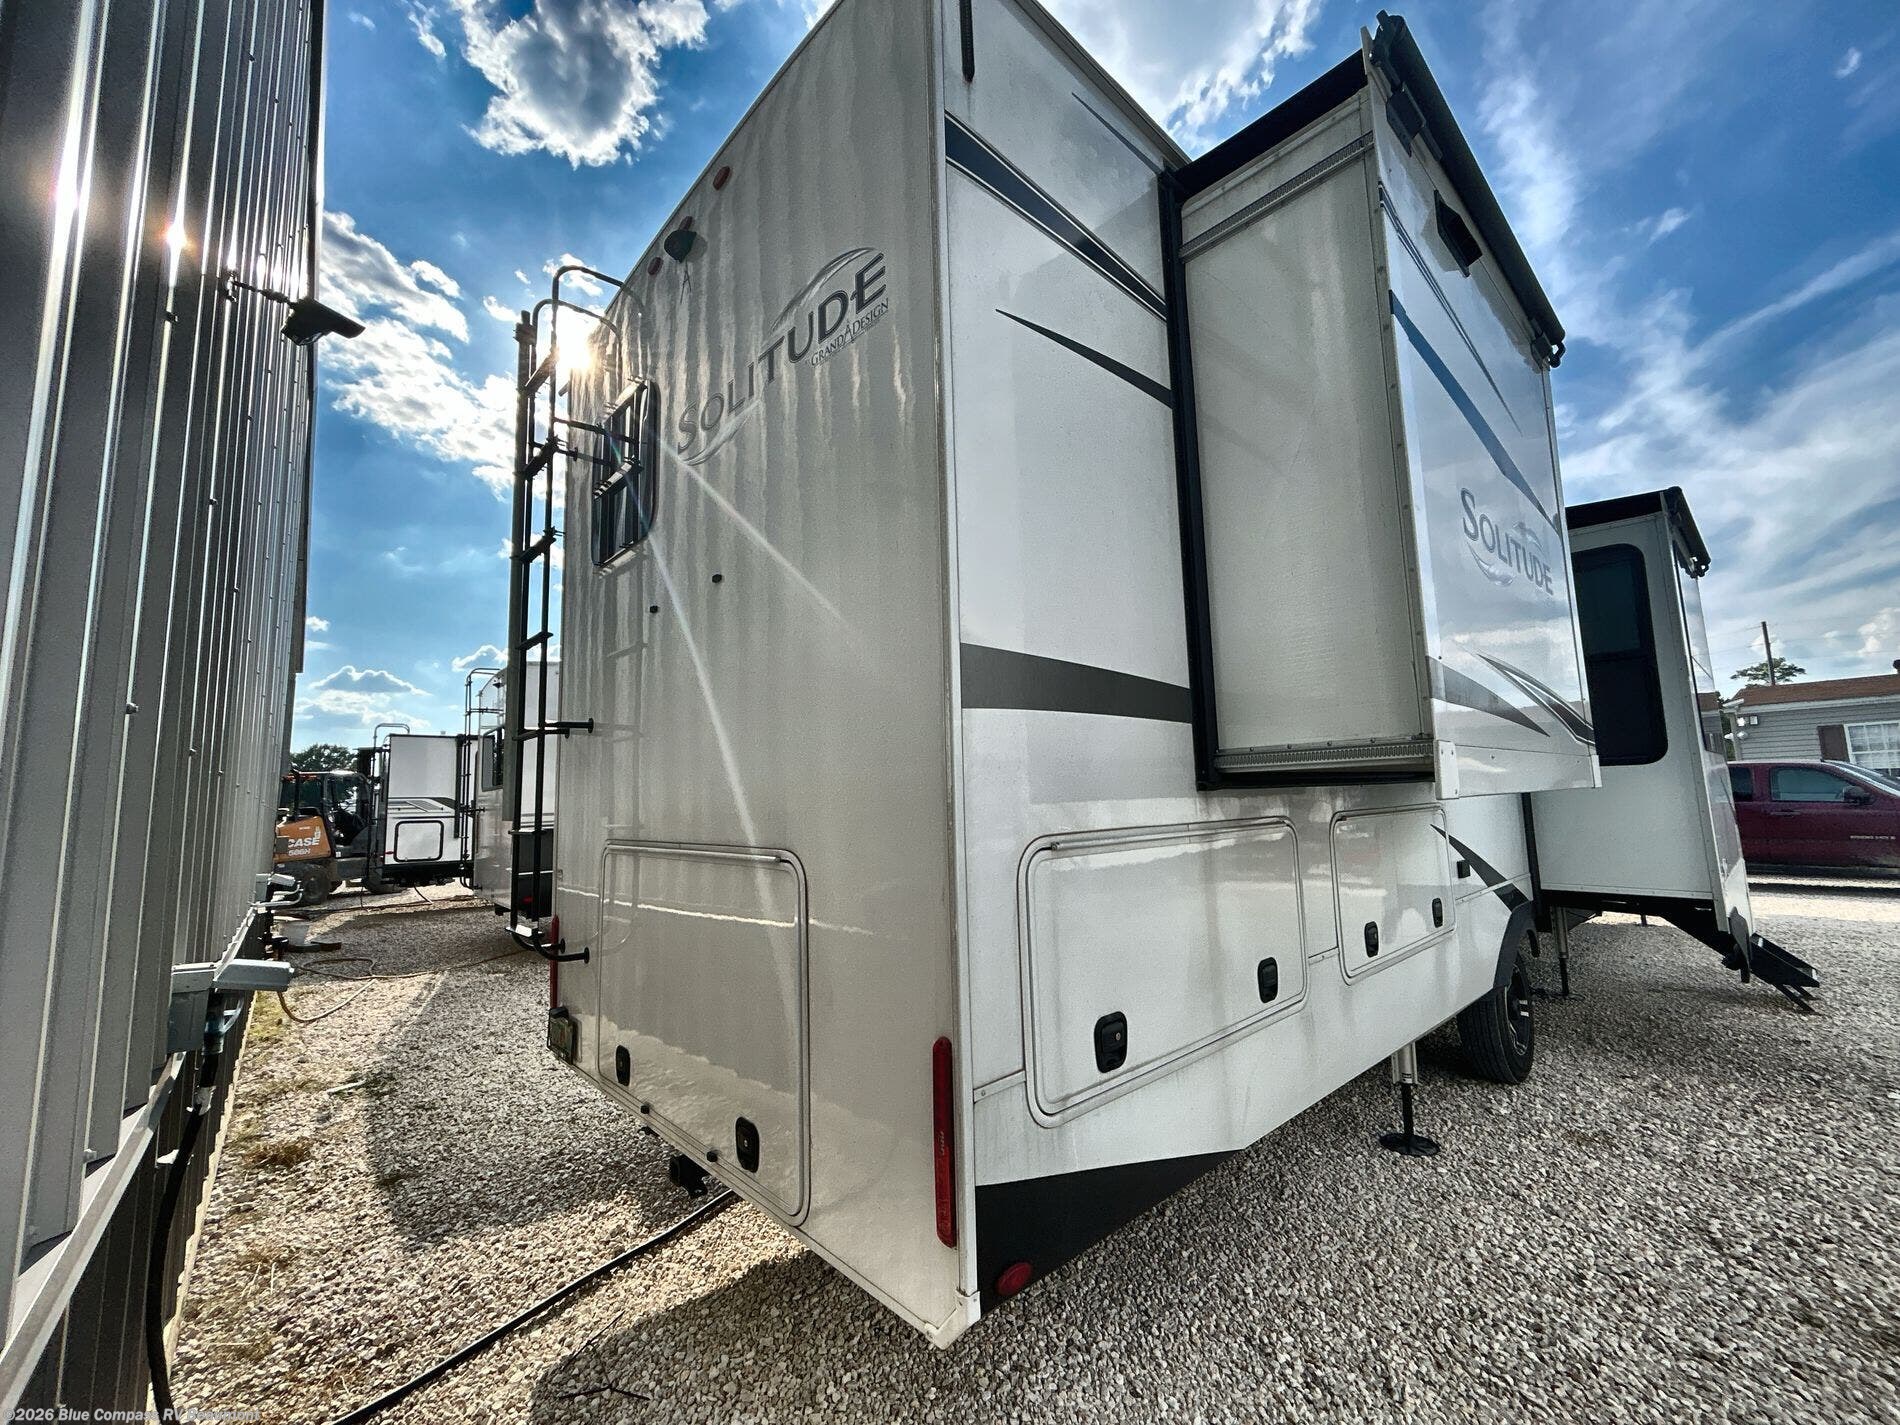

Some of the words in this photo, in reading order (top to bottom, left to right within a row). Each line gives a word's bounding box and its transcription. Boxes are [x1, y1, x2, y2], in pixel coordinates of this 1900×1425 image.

[677, 252, 887, 455] SOLITUDE
[1460, 487, 1554, 596] SOLITUDE
[287, 837, 320, 848] CASE
